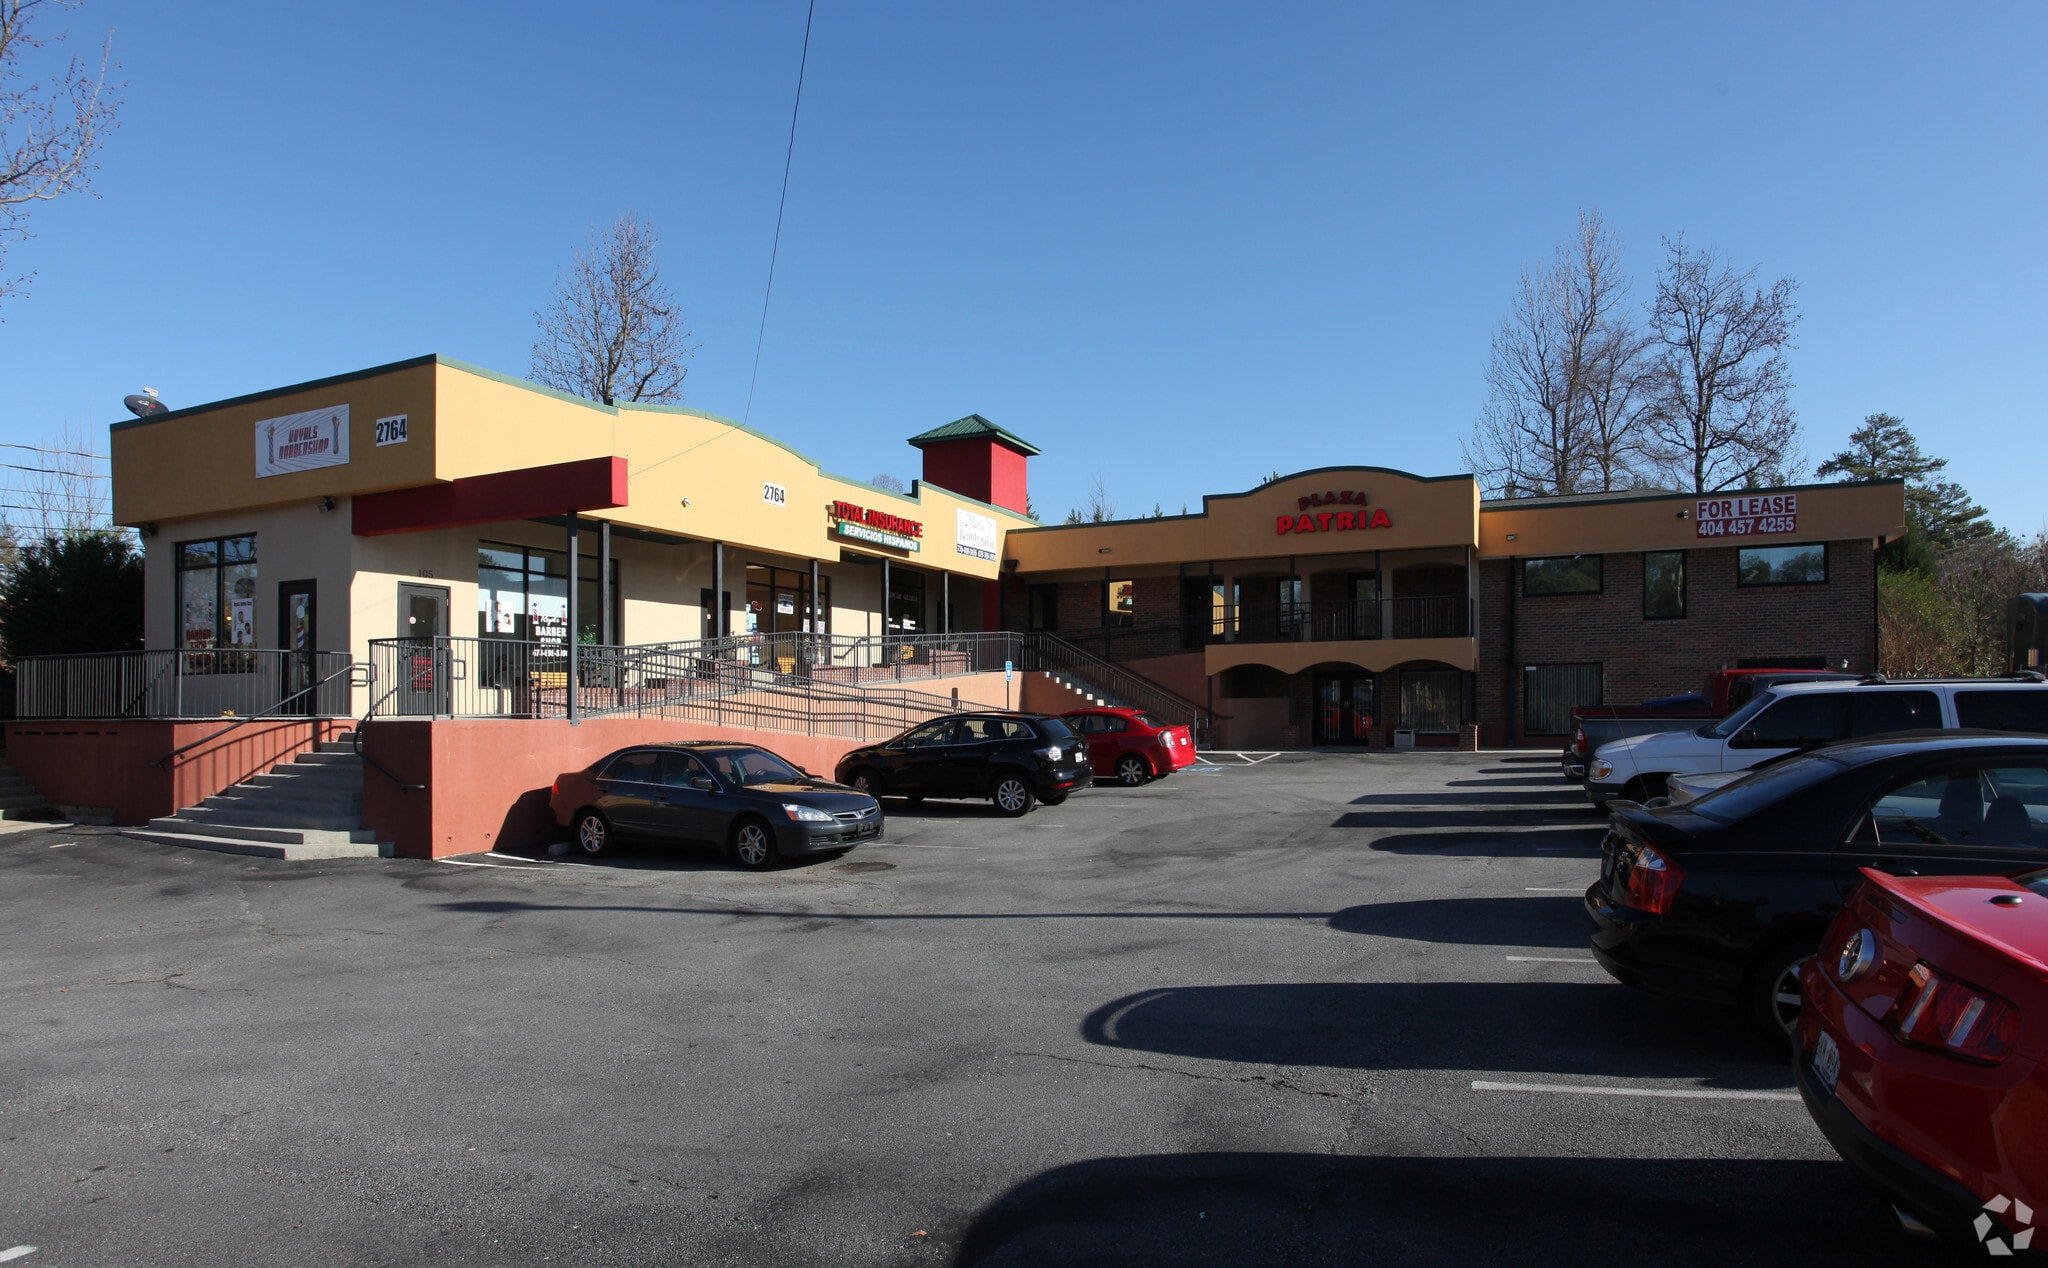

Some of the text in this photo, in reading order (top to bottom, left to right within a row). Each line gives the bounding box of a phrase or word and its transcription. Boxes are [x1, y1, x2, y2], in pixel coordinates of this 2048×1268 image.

[288, 425, 319, 443] ROYALS
[376, 418, 407, 443] 2764
[279, 438, 330, 459] BARBERSHOP
[764, 484, 785, 503] 2764
[1298, 490, 1368, 511] PLAZA
[1698, 495, 1795, 519] FOR LEASE
[834, 500, 923, 538] TOTAL INSURANCE
[1277, 508, 1392, 535] PATRIA
[1698, 516, 1794, 536] 404 457 4255
[844, 524, 918, 551] SERVICIOS HISPANOS
[418, 568, 434, 579] 105
[535, 626, 567, 637] BARBER
